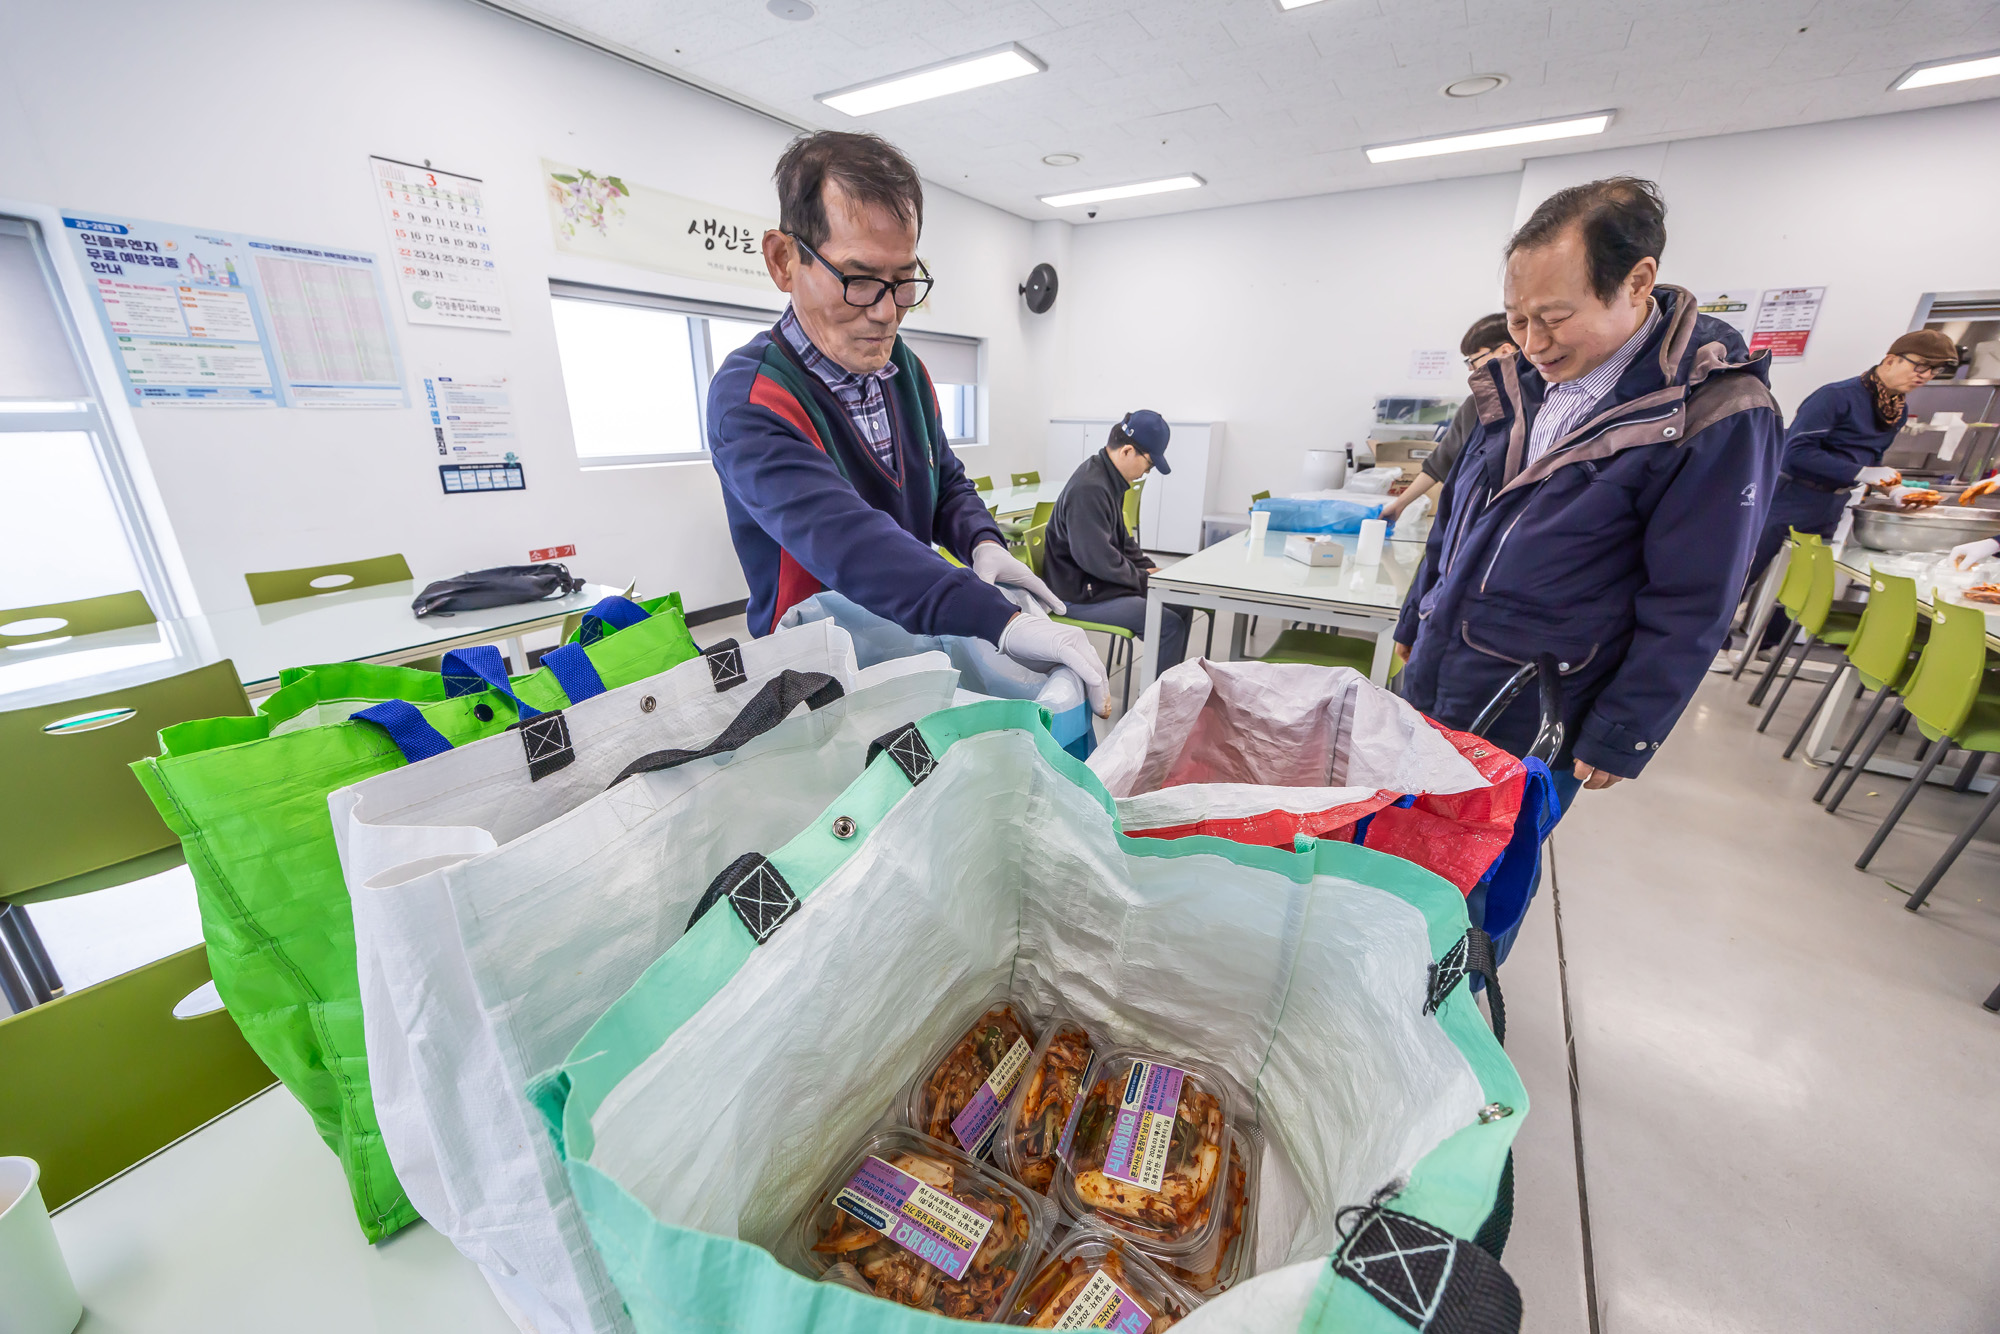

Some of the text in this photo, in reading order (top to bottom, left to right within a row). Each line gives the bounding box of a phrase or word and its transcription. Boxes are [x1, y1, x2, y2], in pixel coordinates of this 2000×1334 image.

[426, 174, 437, 187] 3
[403, 192, 410, 201] 2
[419, 196, 425, 204] 3
[461, 204, 467, 212] 6
[392, 210, 400, 218] 8
[408, 212, 414, 220] 9
[422, 215, 431, 223] 10
[436, 218, 445, 226] 11
[450, 220, 460, 228] 12
[463, 223, 473, 231] 13
[81, 233, 159, 252] 인플루엔자
[396, 229, 490, 251] 15 16 17 18 19 20 21
[688, 219, 756, 253] 생신을
[86, 248, 119, 261] 무료
[398, 248, 494, 268] 22 23 24 25 26 27 28
[90, 262, 123, 275] 안내
[403, 266, 443, 279] 29 30 31
[435, 301, 500, 315] 신정종합사회복지관
[1148, 1094, 1156, 1104] 위한
[1144, 1110, 1152, 1121] 가구
[1141, 1121, 1149, 1134] 남성
[1107, 1112, 1135, 1173] 식사하세요
[1136, 1134, 1146, 1152] 중장년
[1150, 1119, 1169, 1185] 유통기한: 제조일로부터 3일
[1130, 1152, 1142, 1177] 혼자사는
[1142, 1158, 1153, 1183] 제조일자:
[852, 1174, 886, 1196] 밑반찬입니다
[883, 1191, 897, 1202] 위한
[902, 1202, 916, 1214] 가구
[914, 1209, 929, 1222] 남성
[918, 1186, 986, 1229] 유통기한: 제조일로부터 3일
[926, 1217, 947, 1233] 중장년
[954, 1218, 981, 1237] 제조일자:
[892, 1222, 963, 1274] 식사하세요
[945, 1228, 972, 1249] 혼자사는
[1081, 1275, 1104, 1304] 유통기한:
[1088, 1281, 1111, 1311] 제조일자:
[1096, 1293, 1122, 1325] 혼자사는
[1109, 1308, 1122, 1324] 사업의
